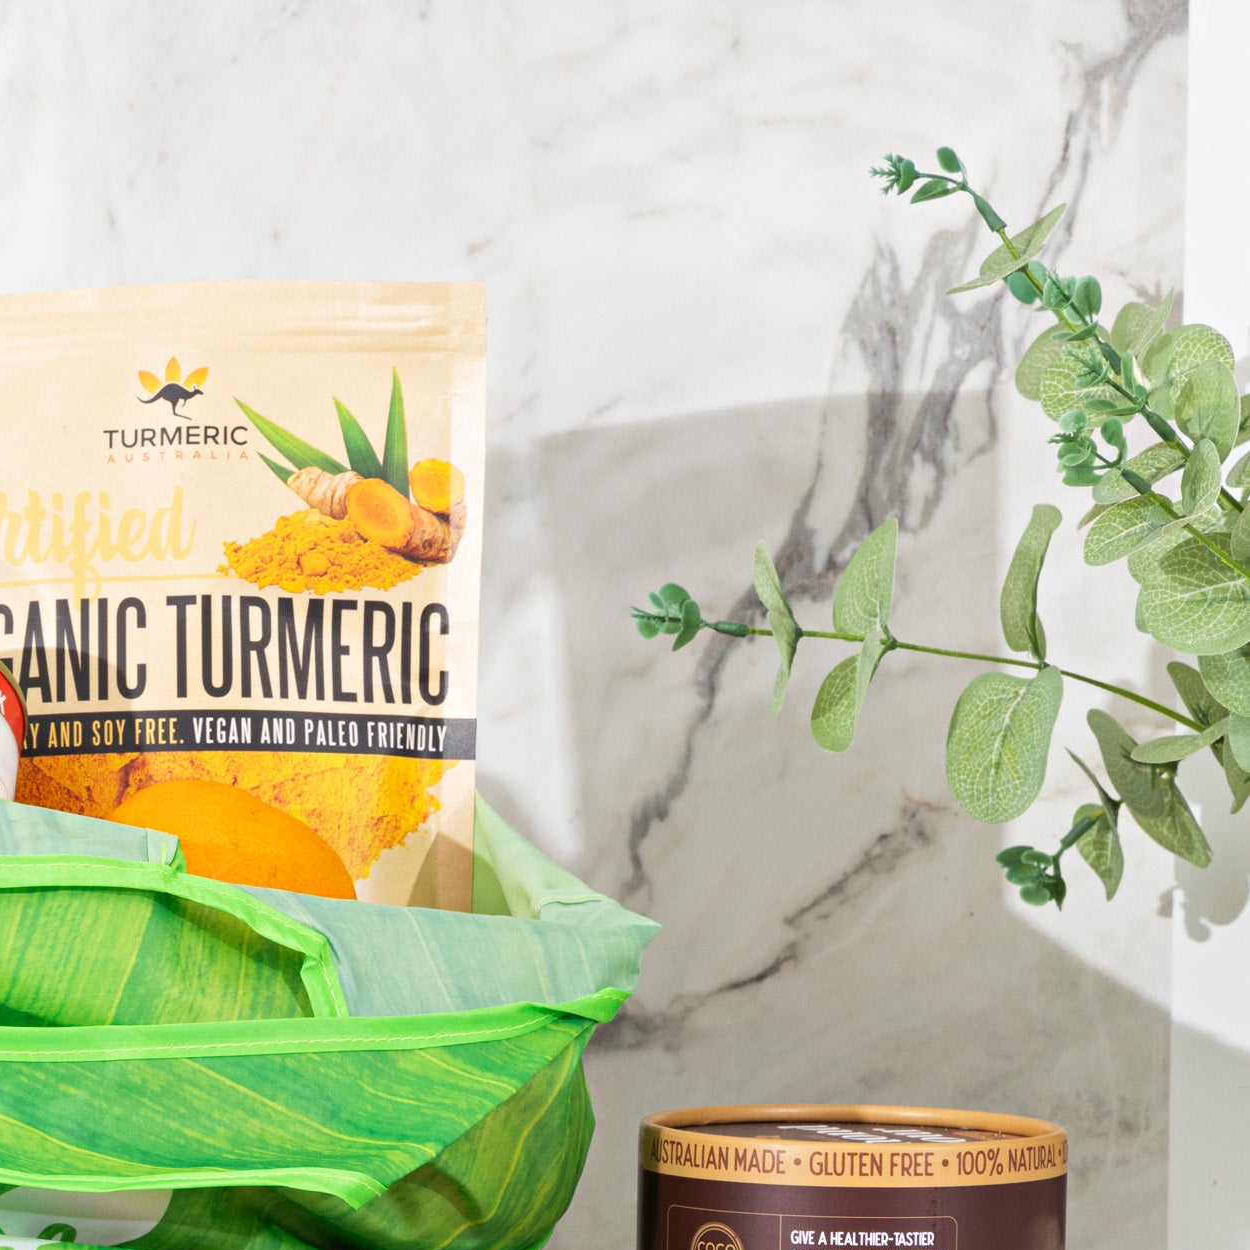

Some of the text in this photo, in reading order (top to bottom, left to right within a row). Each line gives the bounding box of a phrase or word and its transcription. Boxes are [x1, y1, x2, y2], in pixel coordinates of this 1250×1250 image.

[103, 425, 248, 449] TURMERIC
[107, 450, 249, 464] AUSTRALIA
[166, 595, 450, 706] TURMERIC
[48, 720, 83, 748] AND
[92, 719, 126, 747] SOY
[135, 717, 184, 745] FREE.
[192, 717, 252, 745] VEGAN
[260, 717, 295, 745] AND
[304, 718, 359, 748] PALEO
[367, 721, 448, 752] FRIENDLY
[651, 1138, 729, 1171] AUSTRALIAN
[734, 1147, 786, 1174] MADE
[809, 1151, 883, 1177] GLUTEN
[889, 1152, 934, 1177] FREE
[956, 1147, 1004, 1176] 100%
[1008, 1143, 1057, 1173] NATURAL
[790, 1230, 935, 1246] GIVE A HEALTHIER-TASTIER
